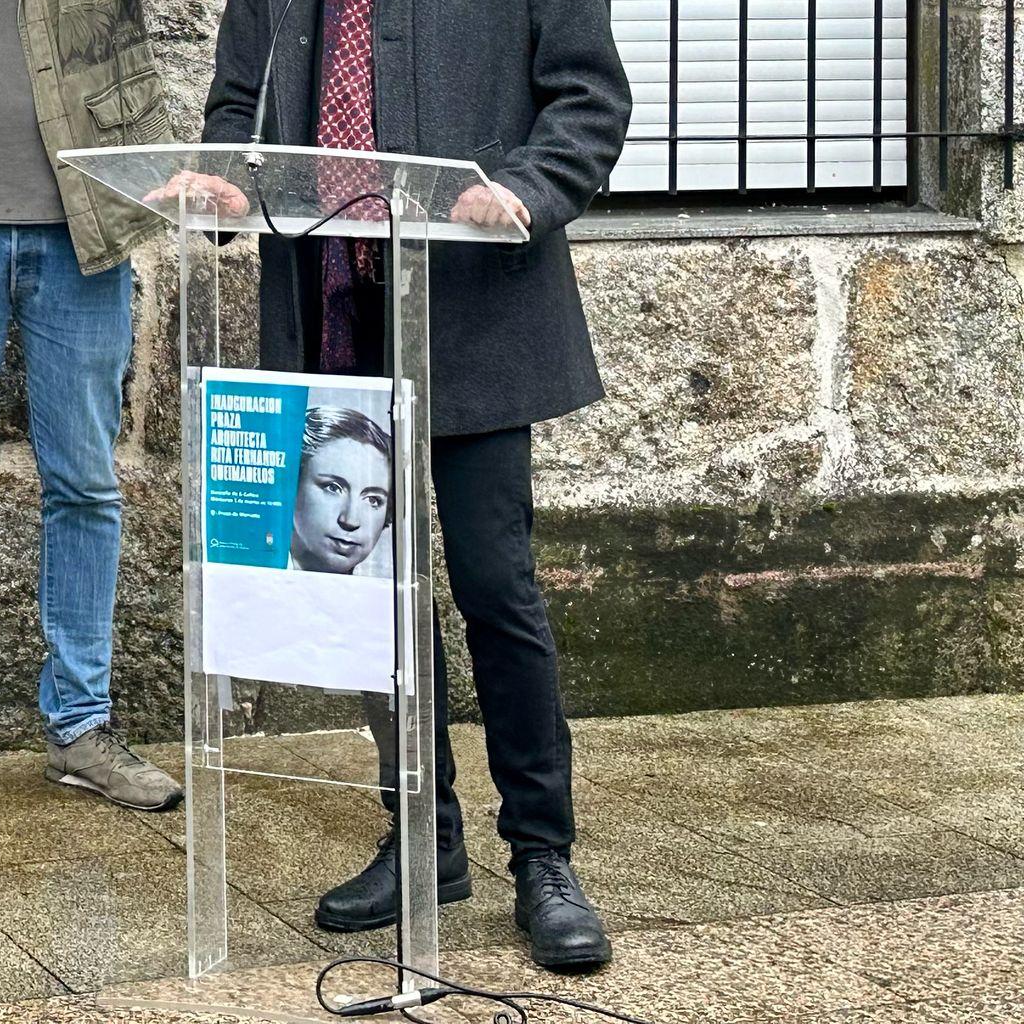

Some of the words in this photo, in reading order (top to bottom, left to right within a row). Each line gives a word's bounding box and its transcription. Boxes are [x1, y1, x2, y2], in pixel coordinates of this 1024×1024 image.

[210, 394, 282, 414] INAUGURACION
[210, 411, 241, 429] PRAZA
[210, 429, 267, 449] ARQUITECTA
[210, 446, 233, 464] RITA
